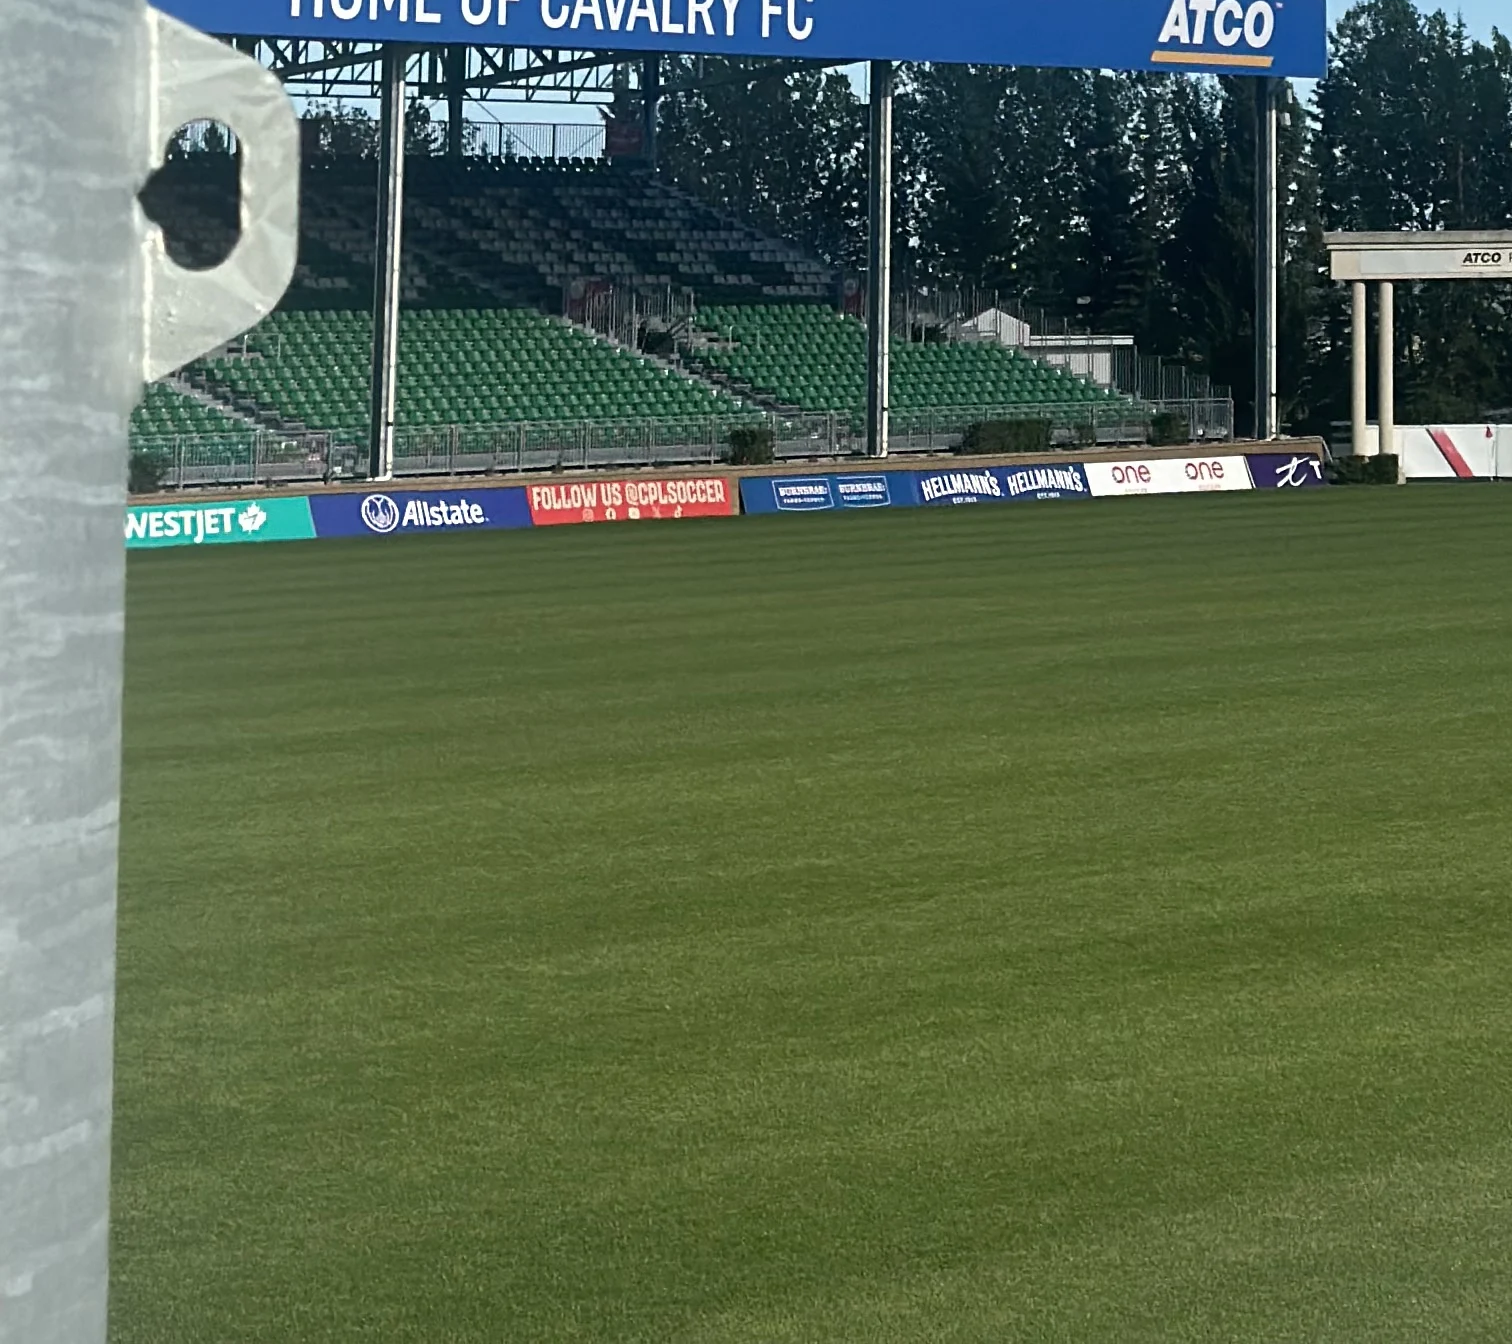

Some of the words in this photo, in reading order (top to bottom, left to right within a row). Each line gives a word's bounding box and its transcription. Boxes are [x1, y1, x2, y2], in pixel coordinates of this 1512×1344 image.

[1463, 252, 1501, 264] ATCO
[921, 469, 1001, 501] HELLMANN'S
[1007, 465, 1083, 496] HELLMANN'S
[1112, 464, 1152, 484] one
[1185, 460, 1225, 480] one
[532, 482, 597, 511] FOLLOW
[601, 481, 622, 507] US
[625, 479, 726, 506] @CPLSOCCER
[124, 507, 236, 544] WESTJET
